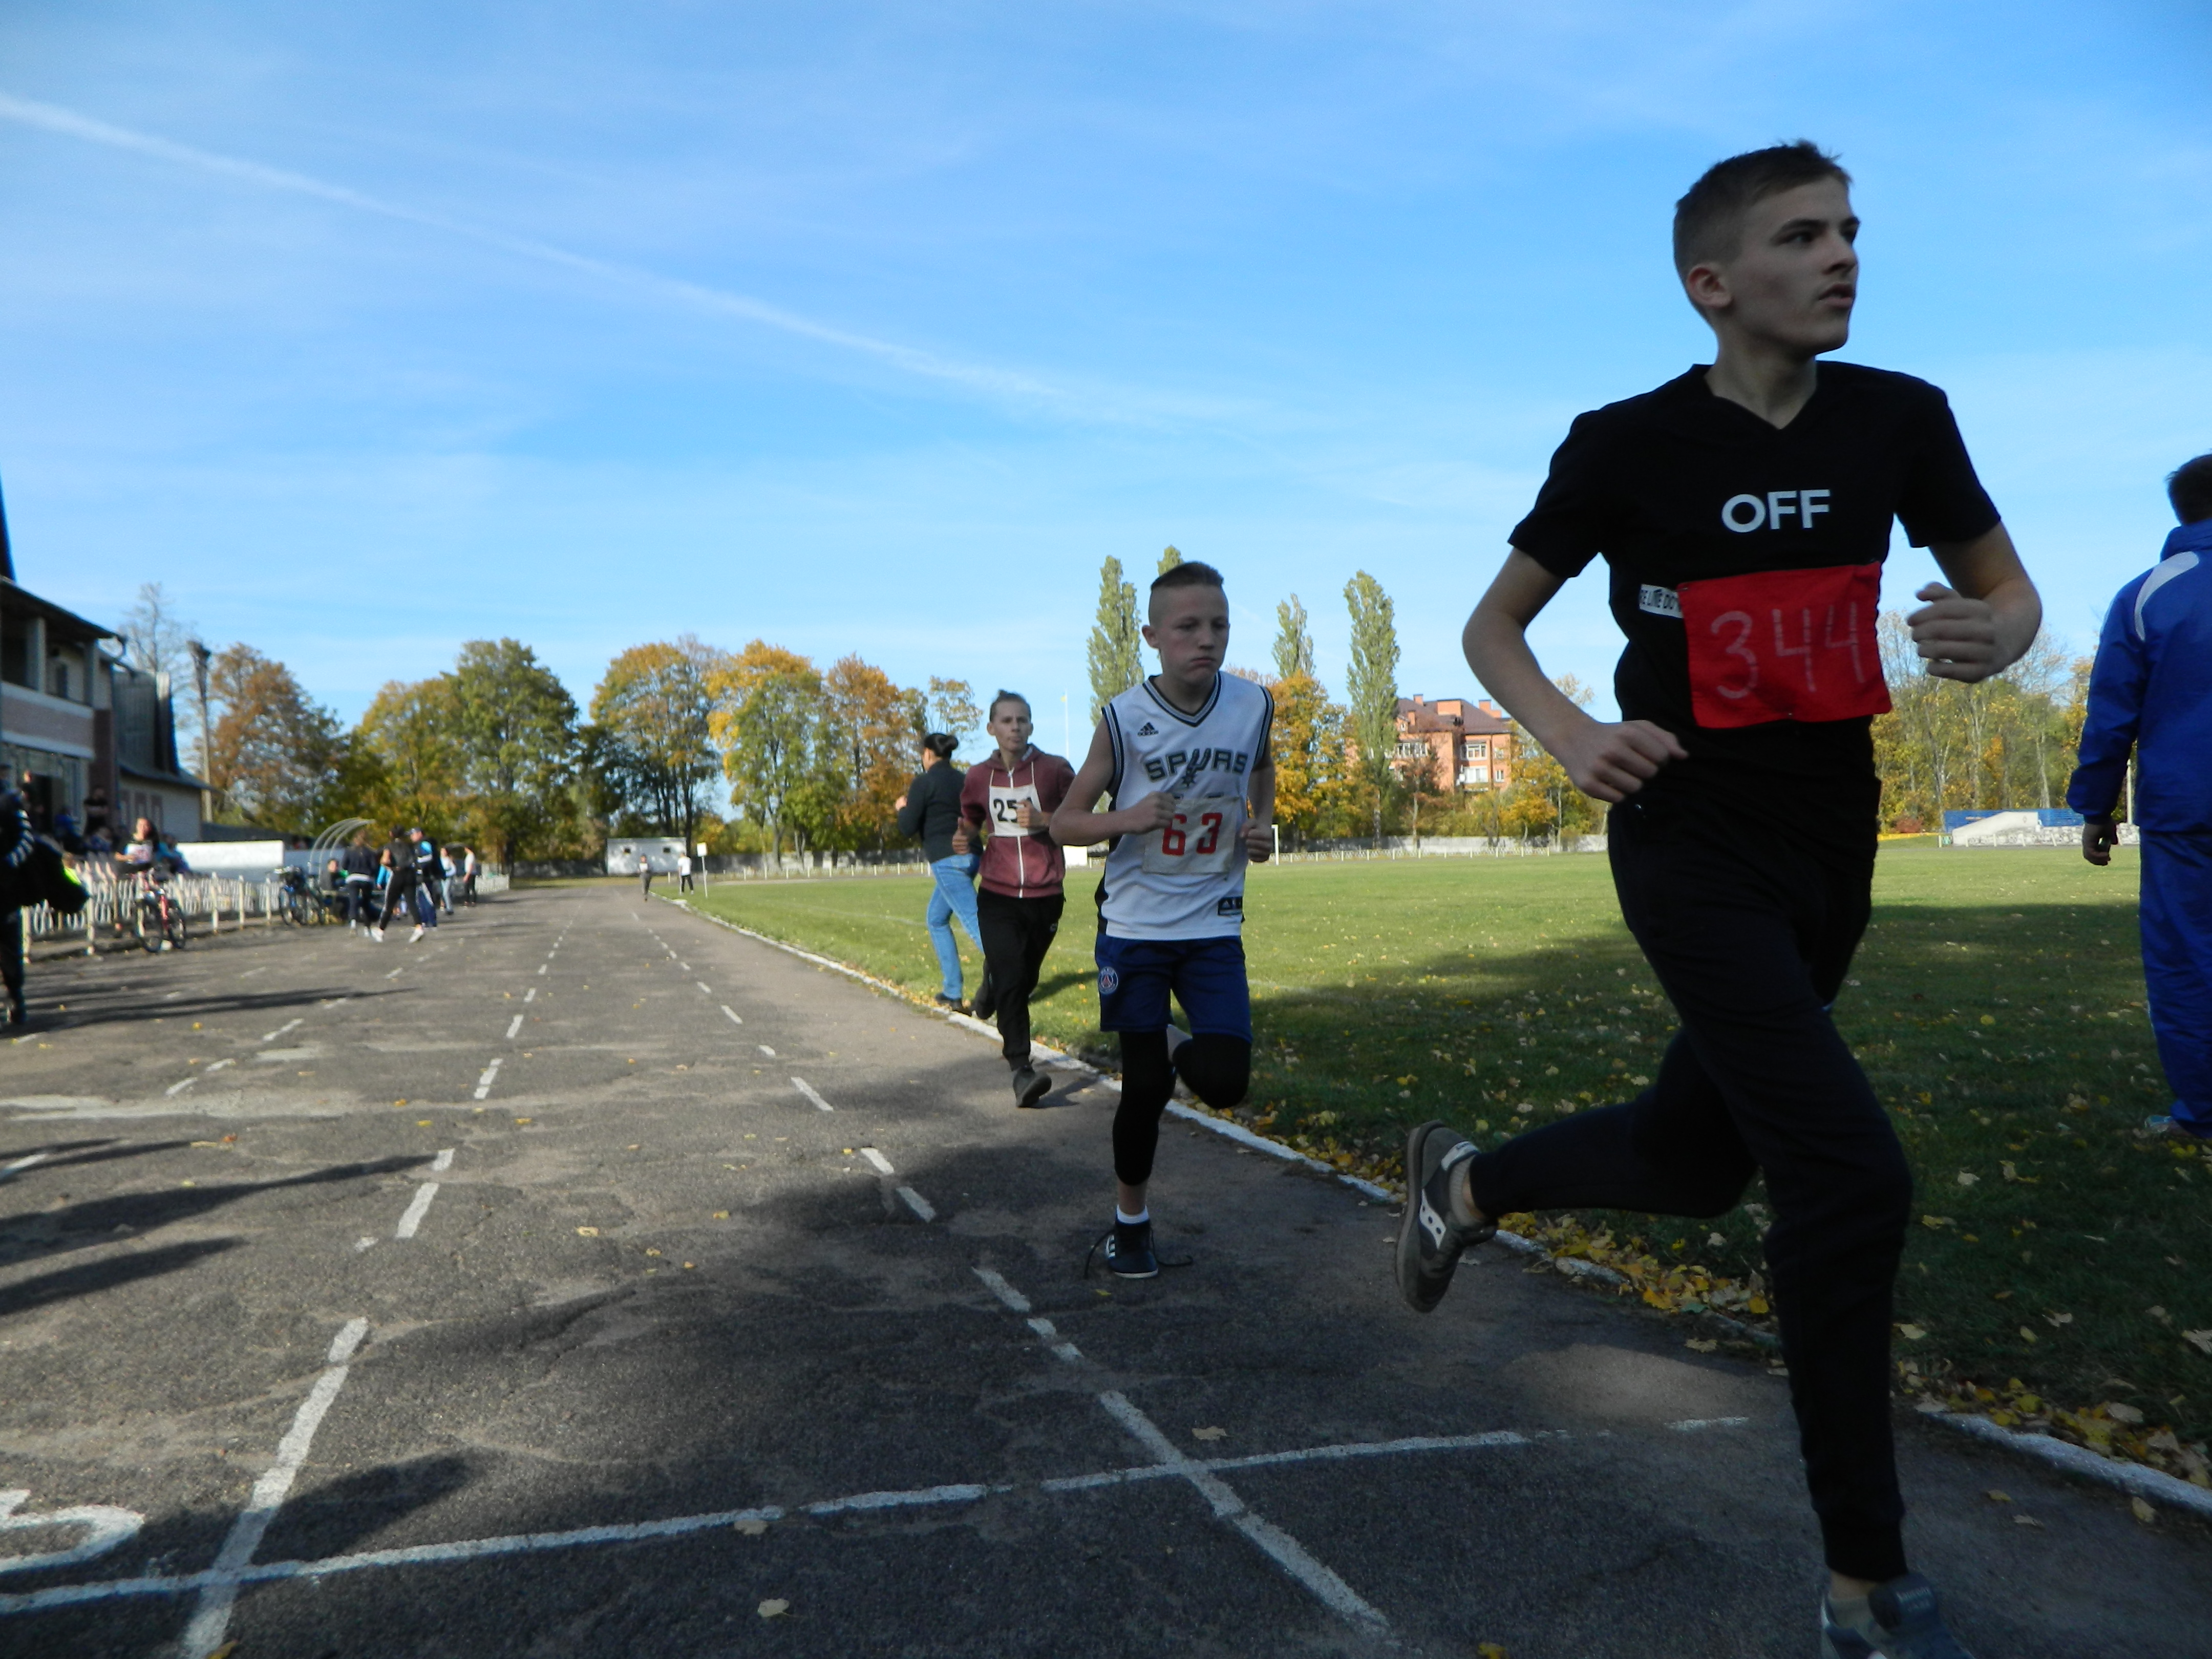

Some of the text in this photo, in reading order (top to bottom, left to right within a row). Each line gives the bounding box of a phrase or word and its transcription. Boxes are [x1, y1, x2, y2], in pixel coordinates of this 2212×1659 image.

[1721, 489, 1830, 533] OFF
[1710, 601, 1866, 699] 344
[1145, 747, 1249, 784] SPURS
[993, 797, 1033, 823] 25
[1161, 812, 1223, 856] 63
